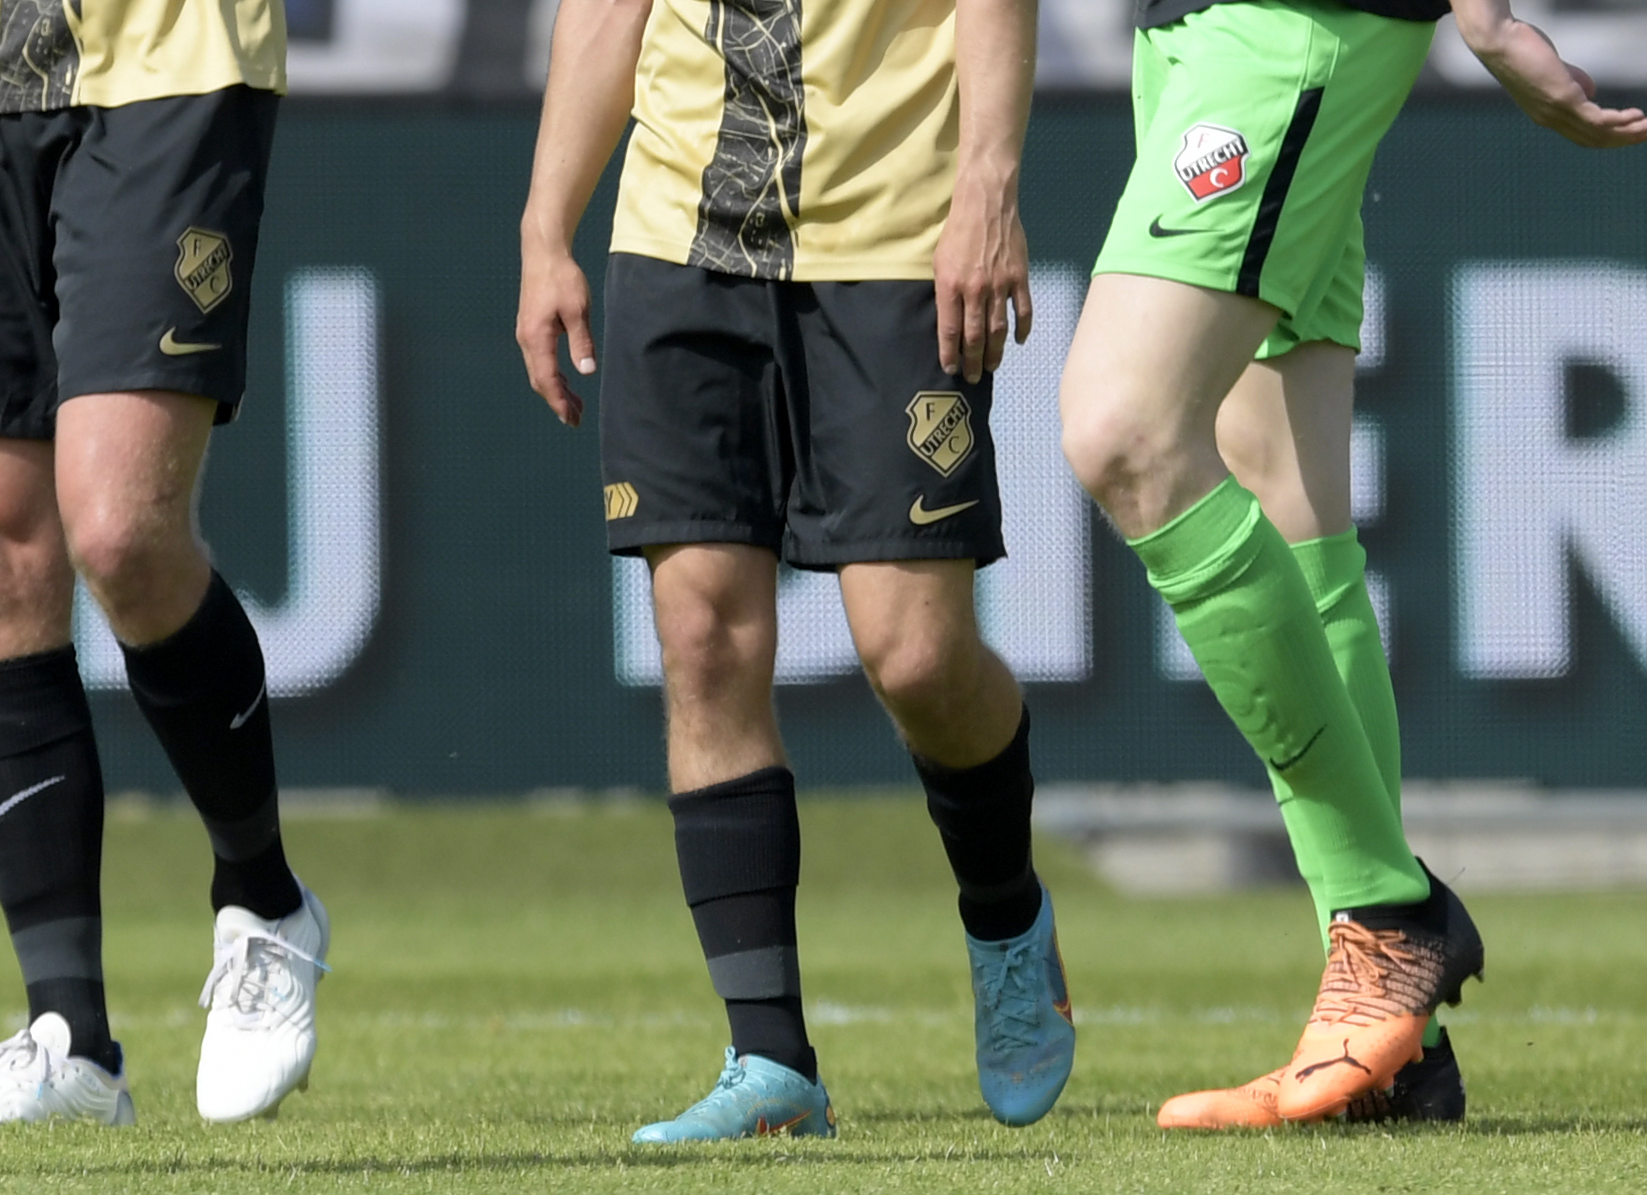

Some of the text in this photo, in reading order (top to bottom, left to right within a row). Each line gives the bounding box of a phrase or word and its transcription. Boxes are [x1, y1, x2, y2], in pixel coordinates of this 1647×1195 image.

[1180, 137, 1244, 182] UTRECHT
[1209, 167, 1228, 188] C
[919, 400, 965, 456] UTRECHT
[926, 402, 935, 421] F
